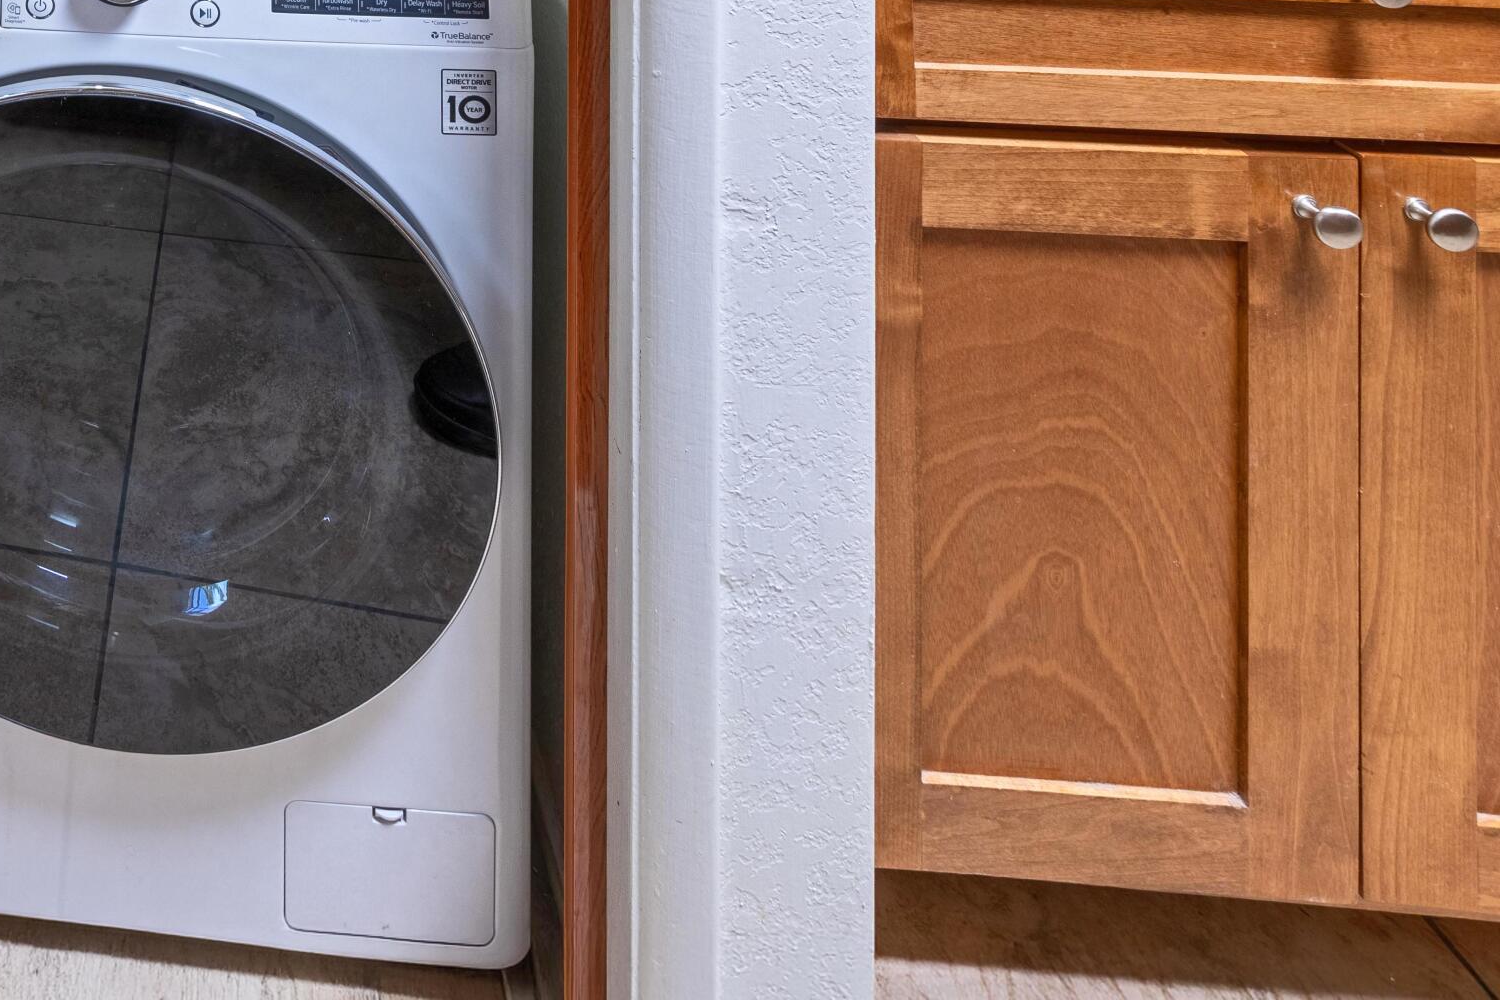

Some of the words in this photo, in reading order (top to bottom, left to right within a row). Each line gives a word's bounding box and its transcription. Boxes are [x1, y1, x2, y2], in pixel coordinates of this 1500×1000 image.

[408, 0, 425, 8] Delay
[452, 1, 472, 9] Heavy
[447, 95, 491, 124] 10
